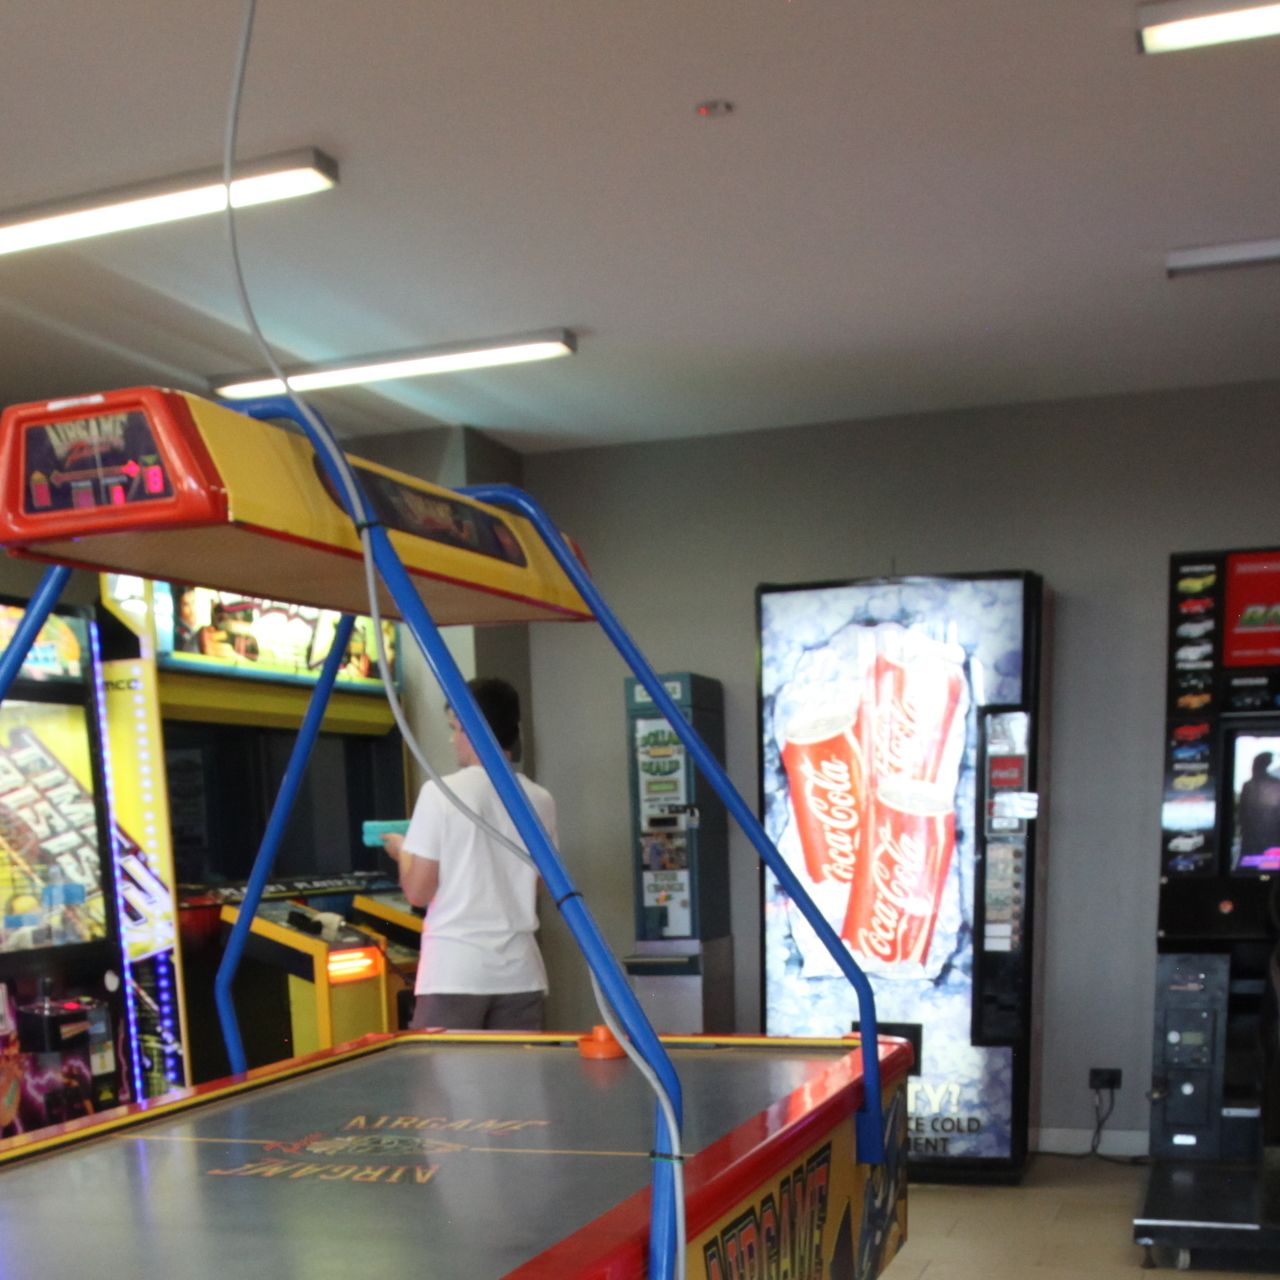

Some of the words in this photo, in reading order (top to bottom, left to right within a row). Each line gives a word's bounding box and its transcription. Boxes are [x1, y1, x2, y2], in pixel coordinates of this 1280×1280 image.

[640, 728, 682, 748] DOLLA
[800, 752, 859, 883] Coca-Cola
[858, 815, 934, 962] Coca-Cola
[931, 1117, 981, 1133] COLD
